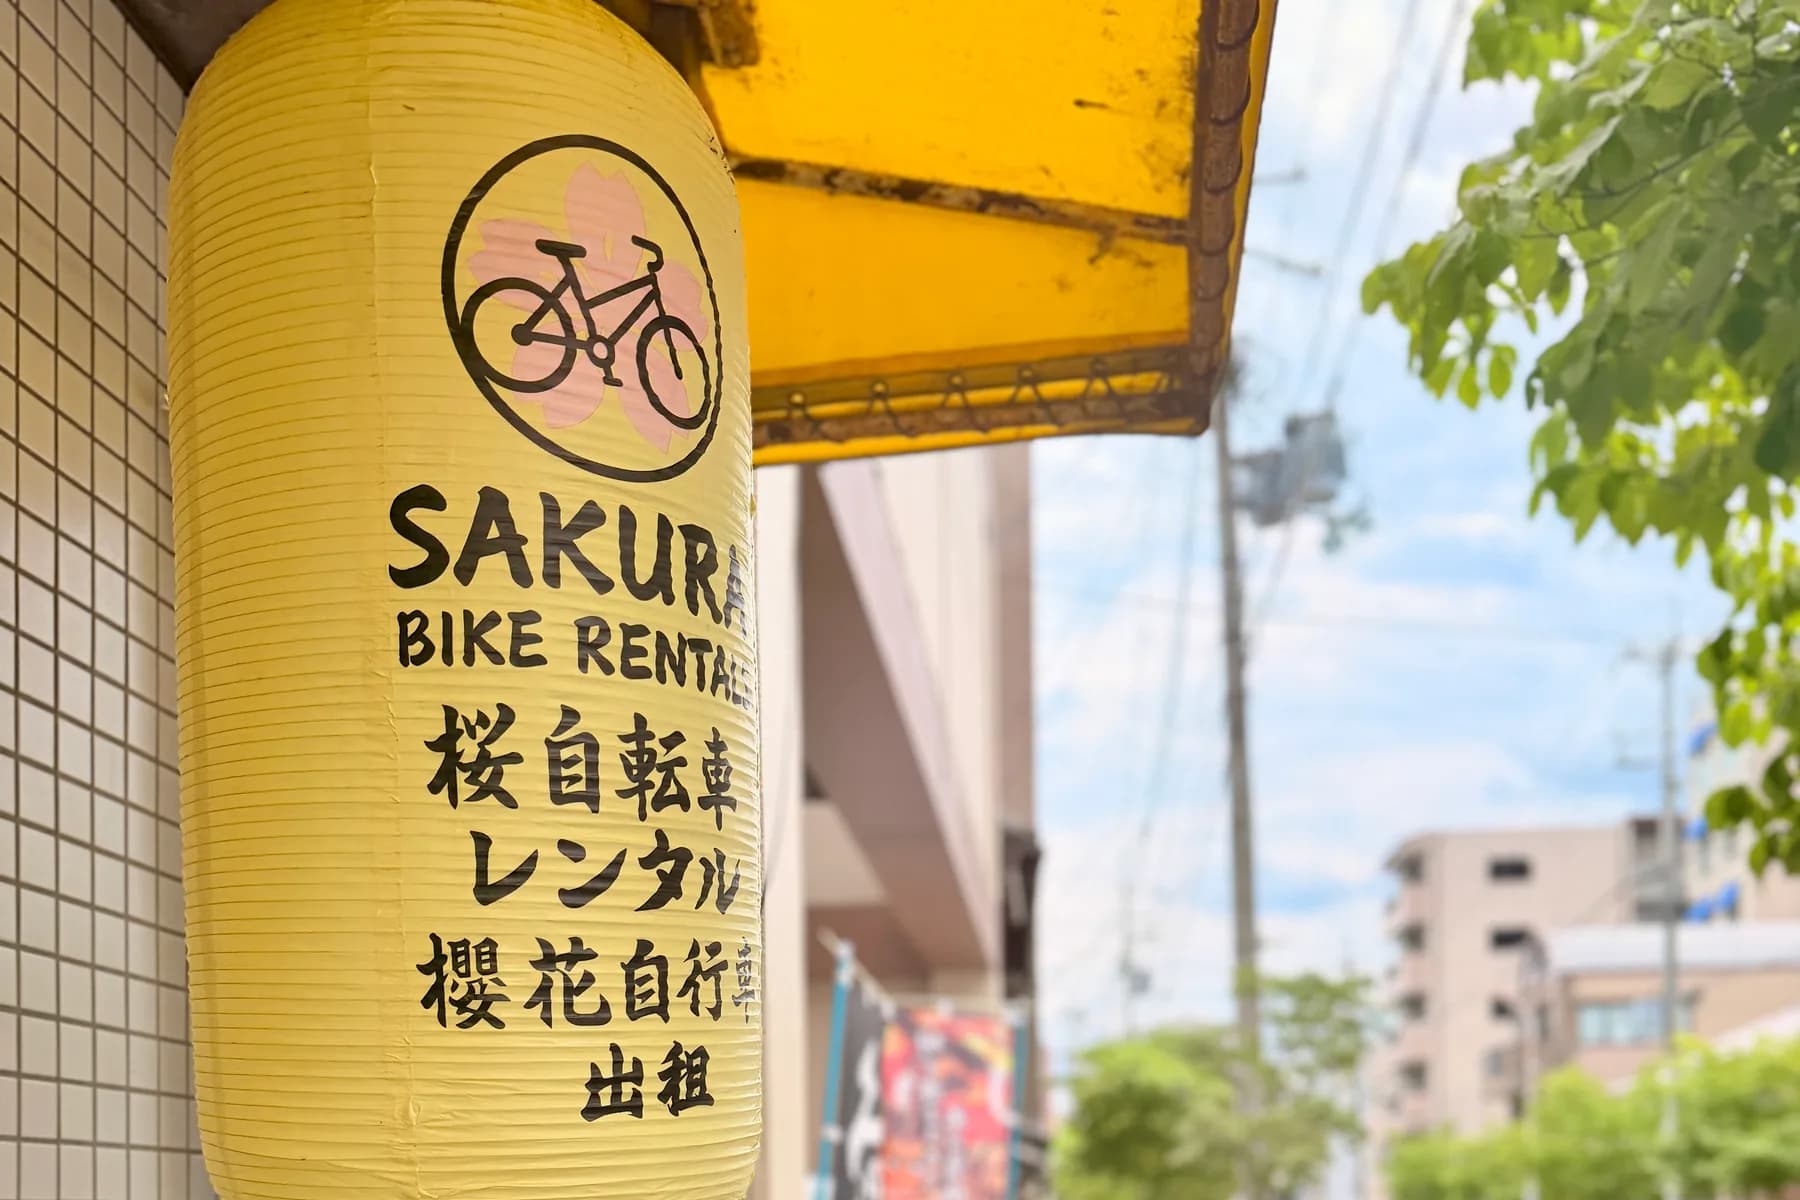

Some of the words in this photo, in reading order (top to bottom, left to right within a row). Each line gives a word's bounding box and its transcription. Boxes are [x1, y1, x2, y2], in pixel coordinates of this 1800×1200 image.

[388, 484, 747, 640] SAKURA
[397, 609, 548, 667] BIKE
[423, 702, 738, 831] 桜自転車
[469, 828, 741, 915] レンタル
[415, 932, 755, 1029] 櫻花自行車
[580, 1040, 715, 1122] 出租
